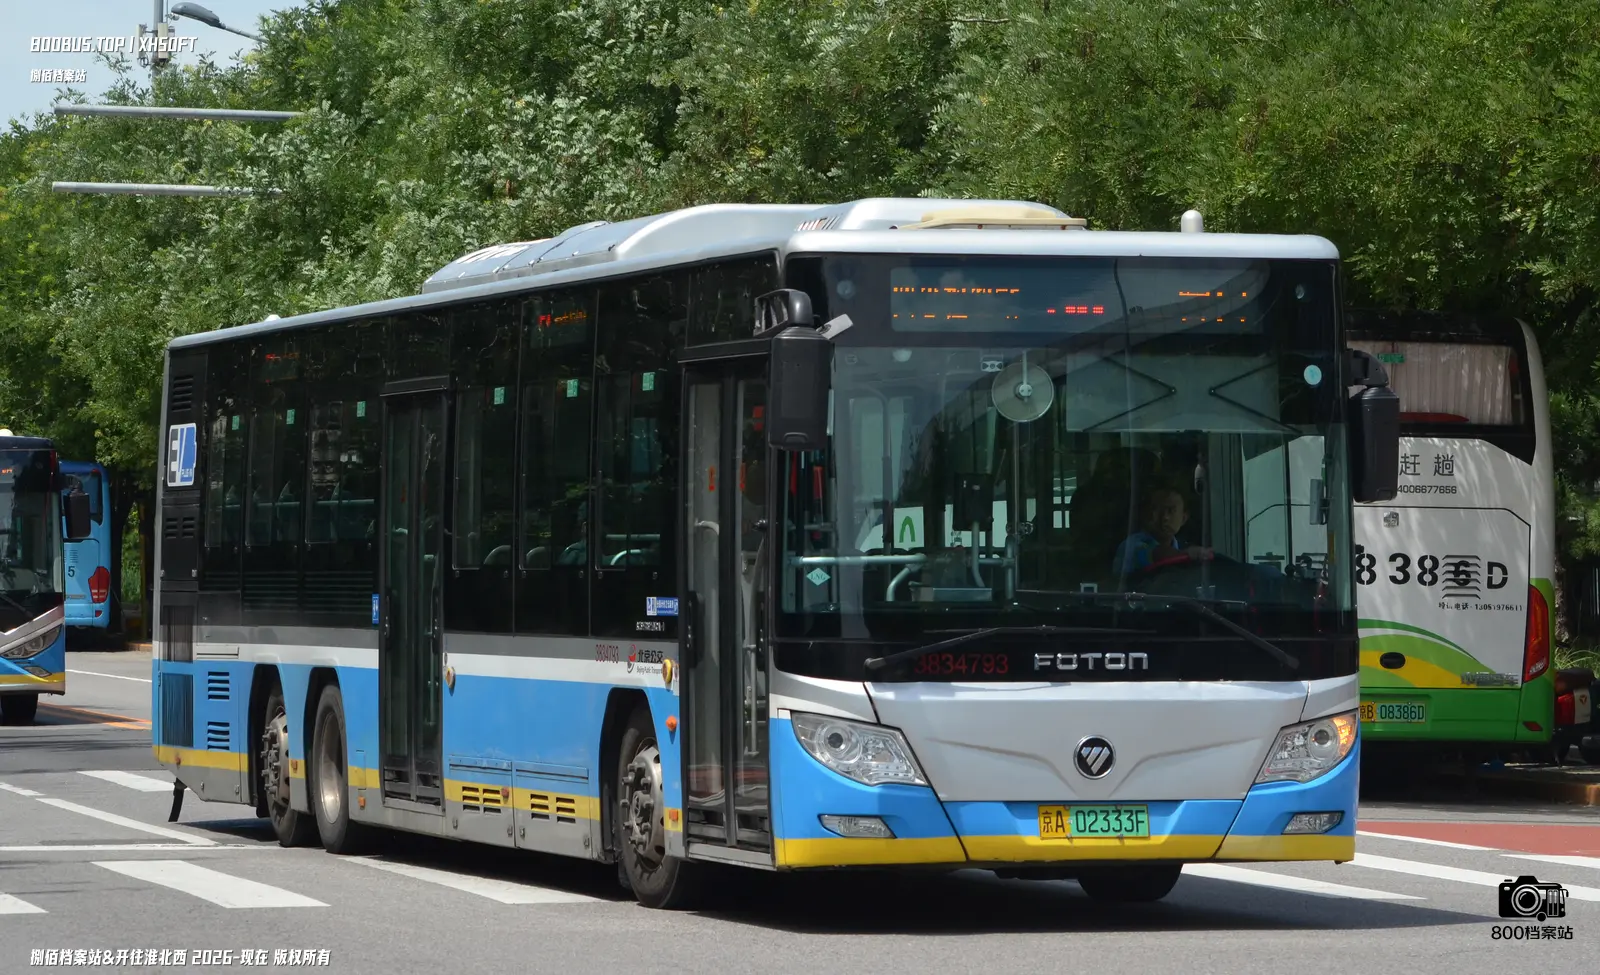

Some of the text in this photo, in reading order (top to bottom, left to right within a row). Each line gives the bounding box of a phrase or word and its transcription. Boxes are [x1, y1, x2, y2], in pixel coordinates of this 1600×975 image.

[1397, 485, 1457, 494] 4006677656
[67, 566, 76, 578] 5
[637, 649, 664, 664] 北京公交
[914, 653, 1009, 675] 3834793
[1034, 652, 1149, 670] FOTON
[1380, 704, 1425, 720] 08386D
[1041, 809, 1146, 834] 京A 02333F
